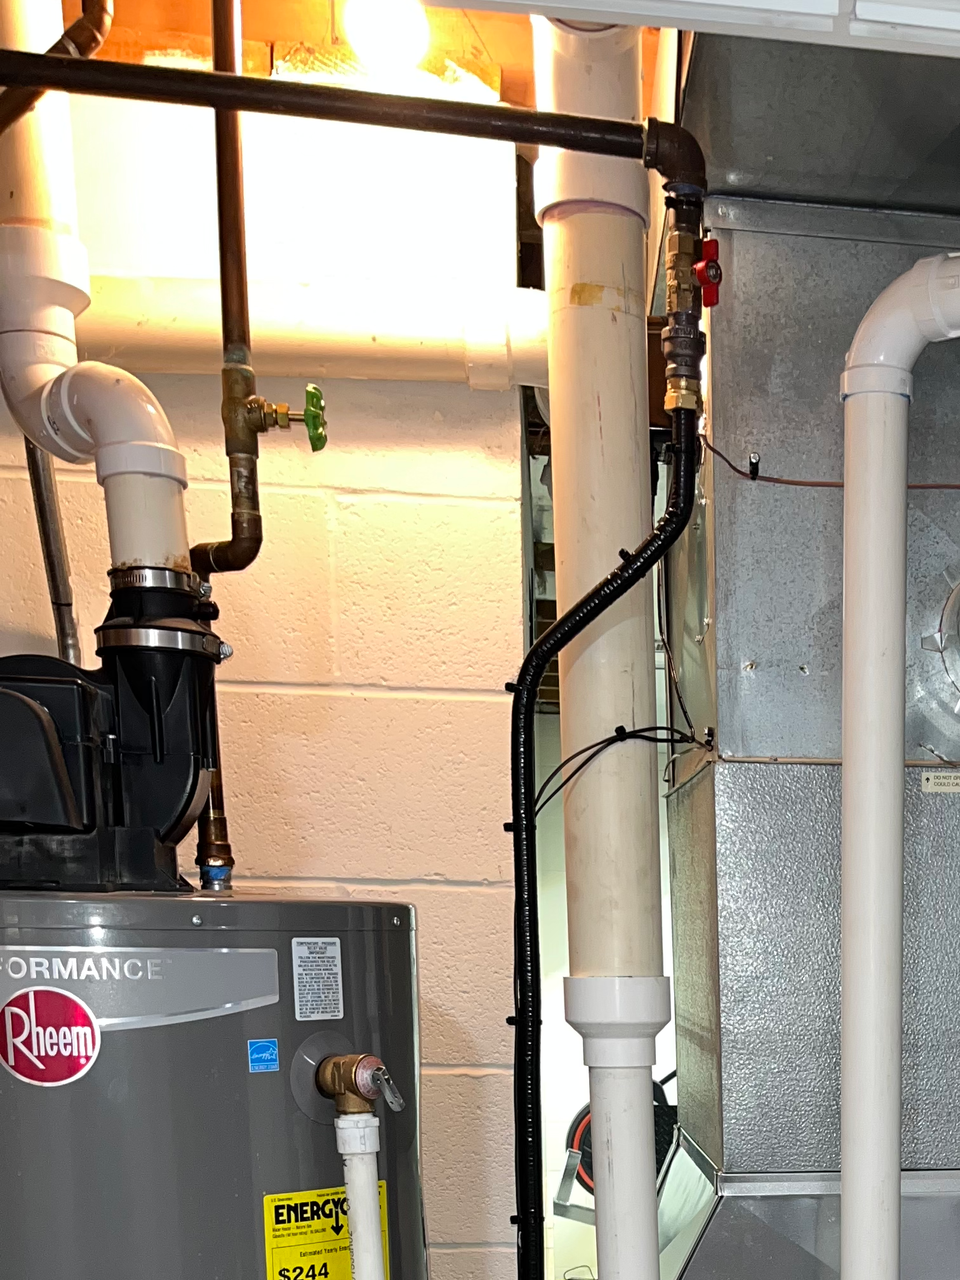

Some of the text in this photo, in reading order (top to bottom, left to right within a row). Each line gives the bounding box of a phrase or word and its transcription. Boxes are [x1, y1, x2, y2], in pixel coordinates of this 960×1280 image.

[0, 957, 163, 980] ORMANCE
[4, 990, 93, 1070] Rheem
[299, 1247, 323, 1258] Estimated
